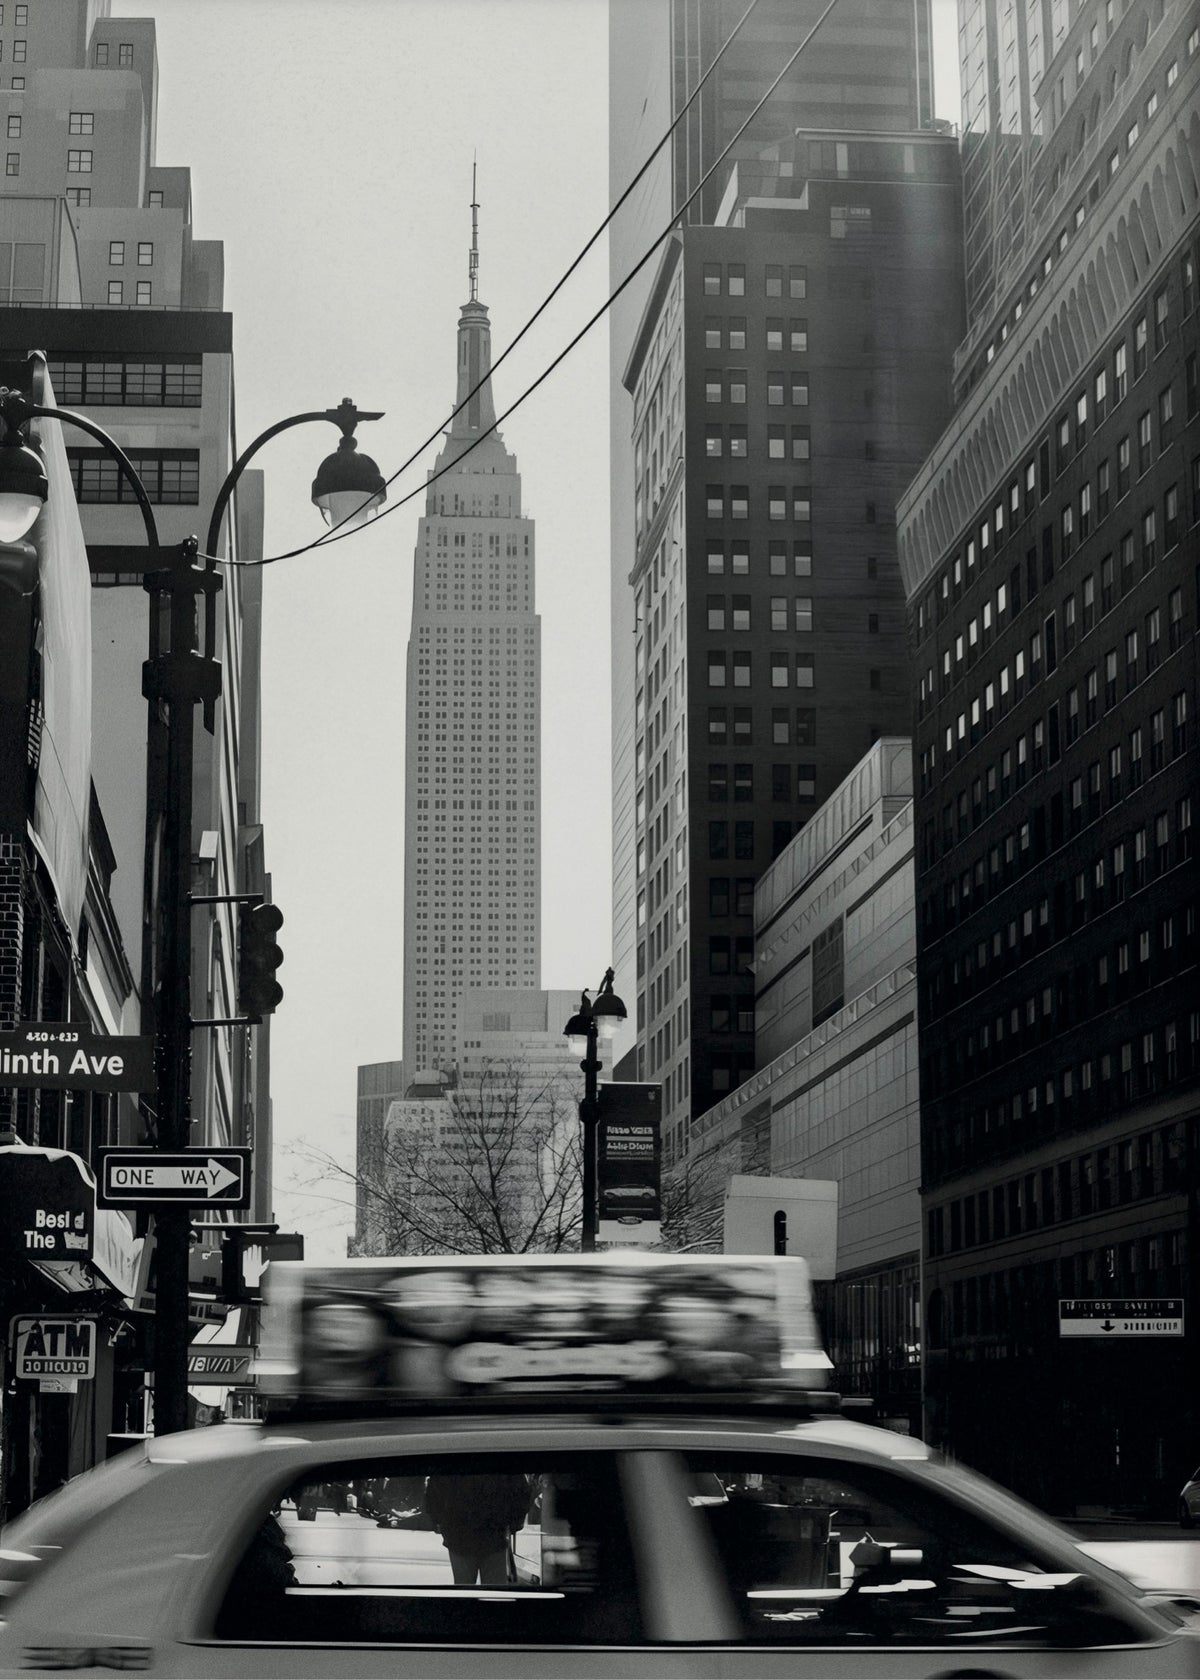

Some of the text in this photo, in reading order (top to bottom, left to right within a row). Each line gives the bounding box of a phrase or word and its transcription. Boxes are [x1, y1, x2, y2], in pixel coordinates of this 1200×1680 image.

[0, 1048, 125, 1076] inth Ave
[116, 1169, 221, 1185] ONE WAY
[23, 1231, 56, 1249] The
[23, 1321, 91, 1358] ATM
